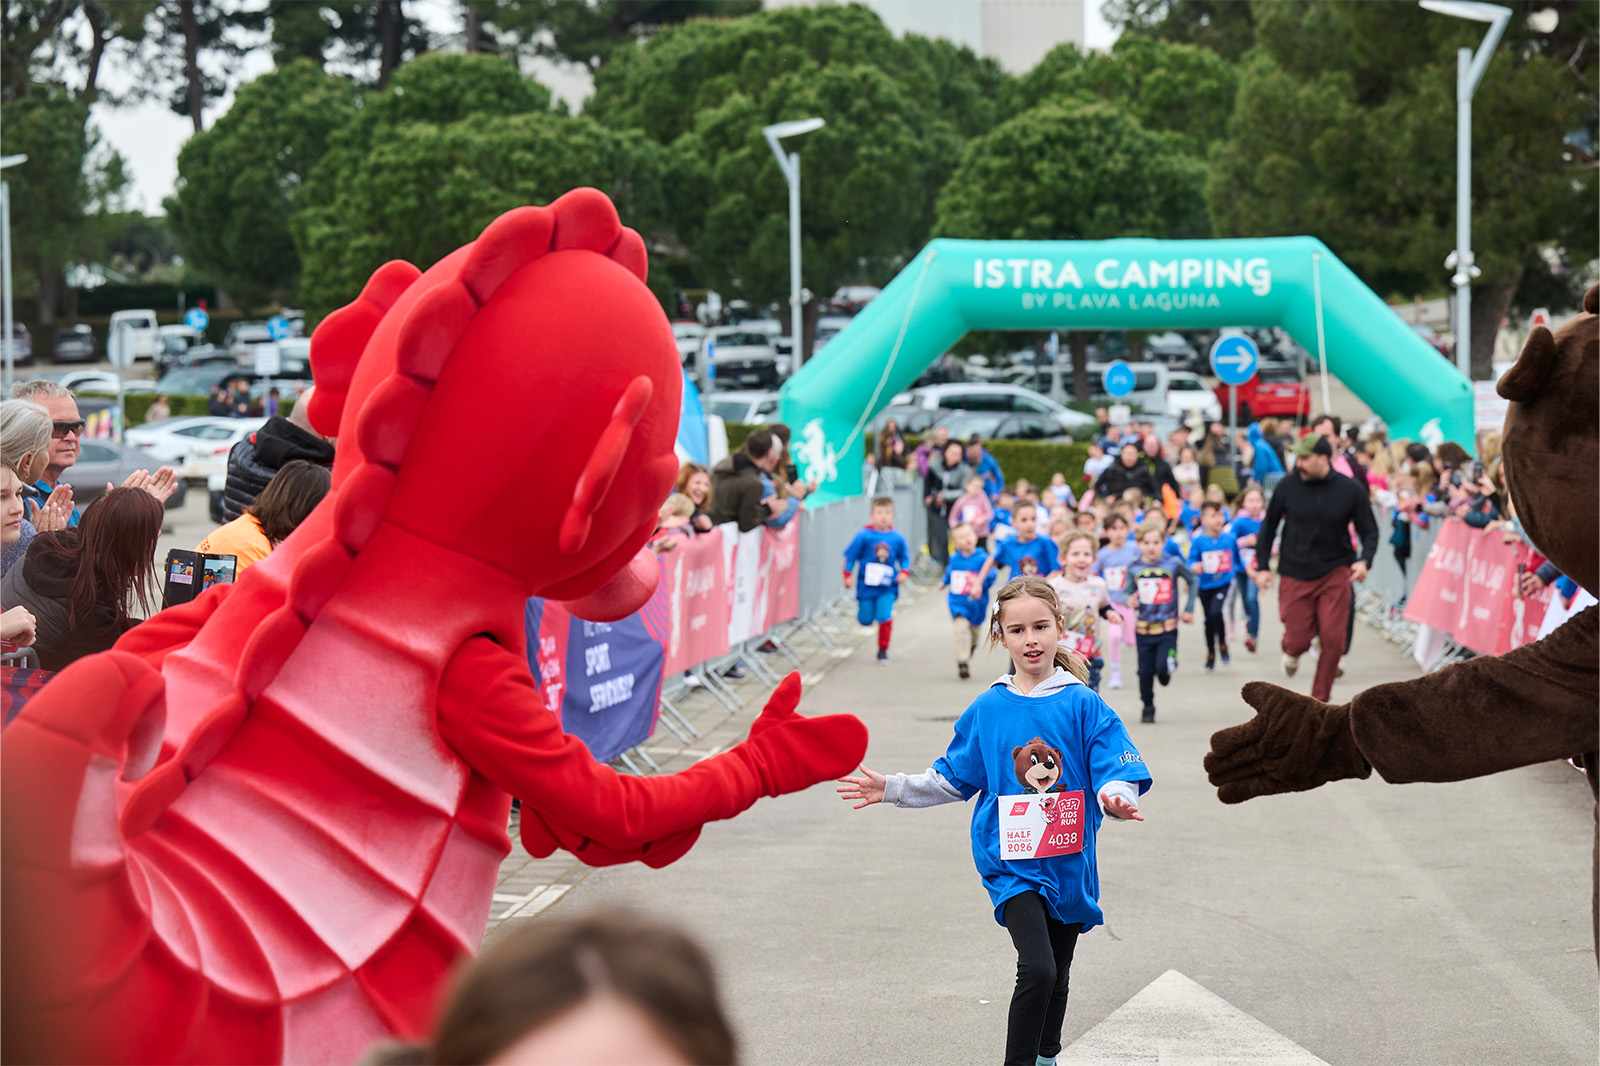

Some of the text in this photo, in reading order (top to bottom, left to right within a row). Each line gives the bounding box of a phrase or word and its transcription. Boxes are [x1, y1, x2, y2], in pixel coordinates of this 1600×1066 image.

[973, 257, 1272, 297] ISTRA CAMPING
[1021, 292, 1221, 312] BY PLAVA LAGUNA
[1057, 798, 1080, 812] PEPI
[1060, 811, 1077, 819] KIDS
[1060, 818, 1077, 826] RUN
[1007, 830, 1031, 839] HALF
[1048, 832, 1078, 846] 4038
[1007, 843, 1033, 852] 2026
